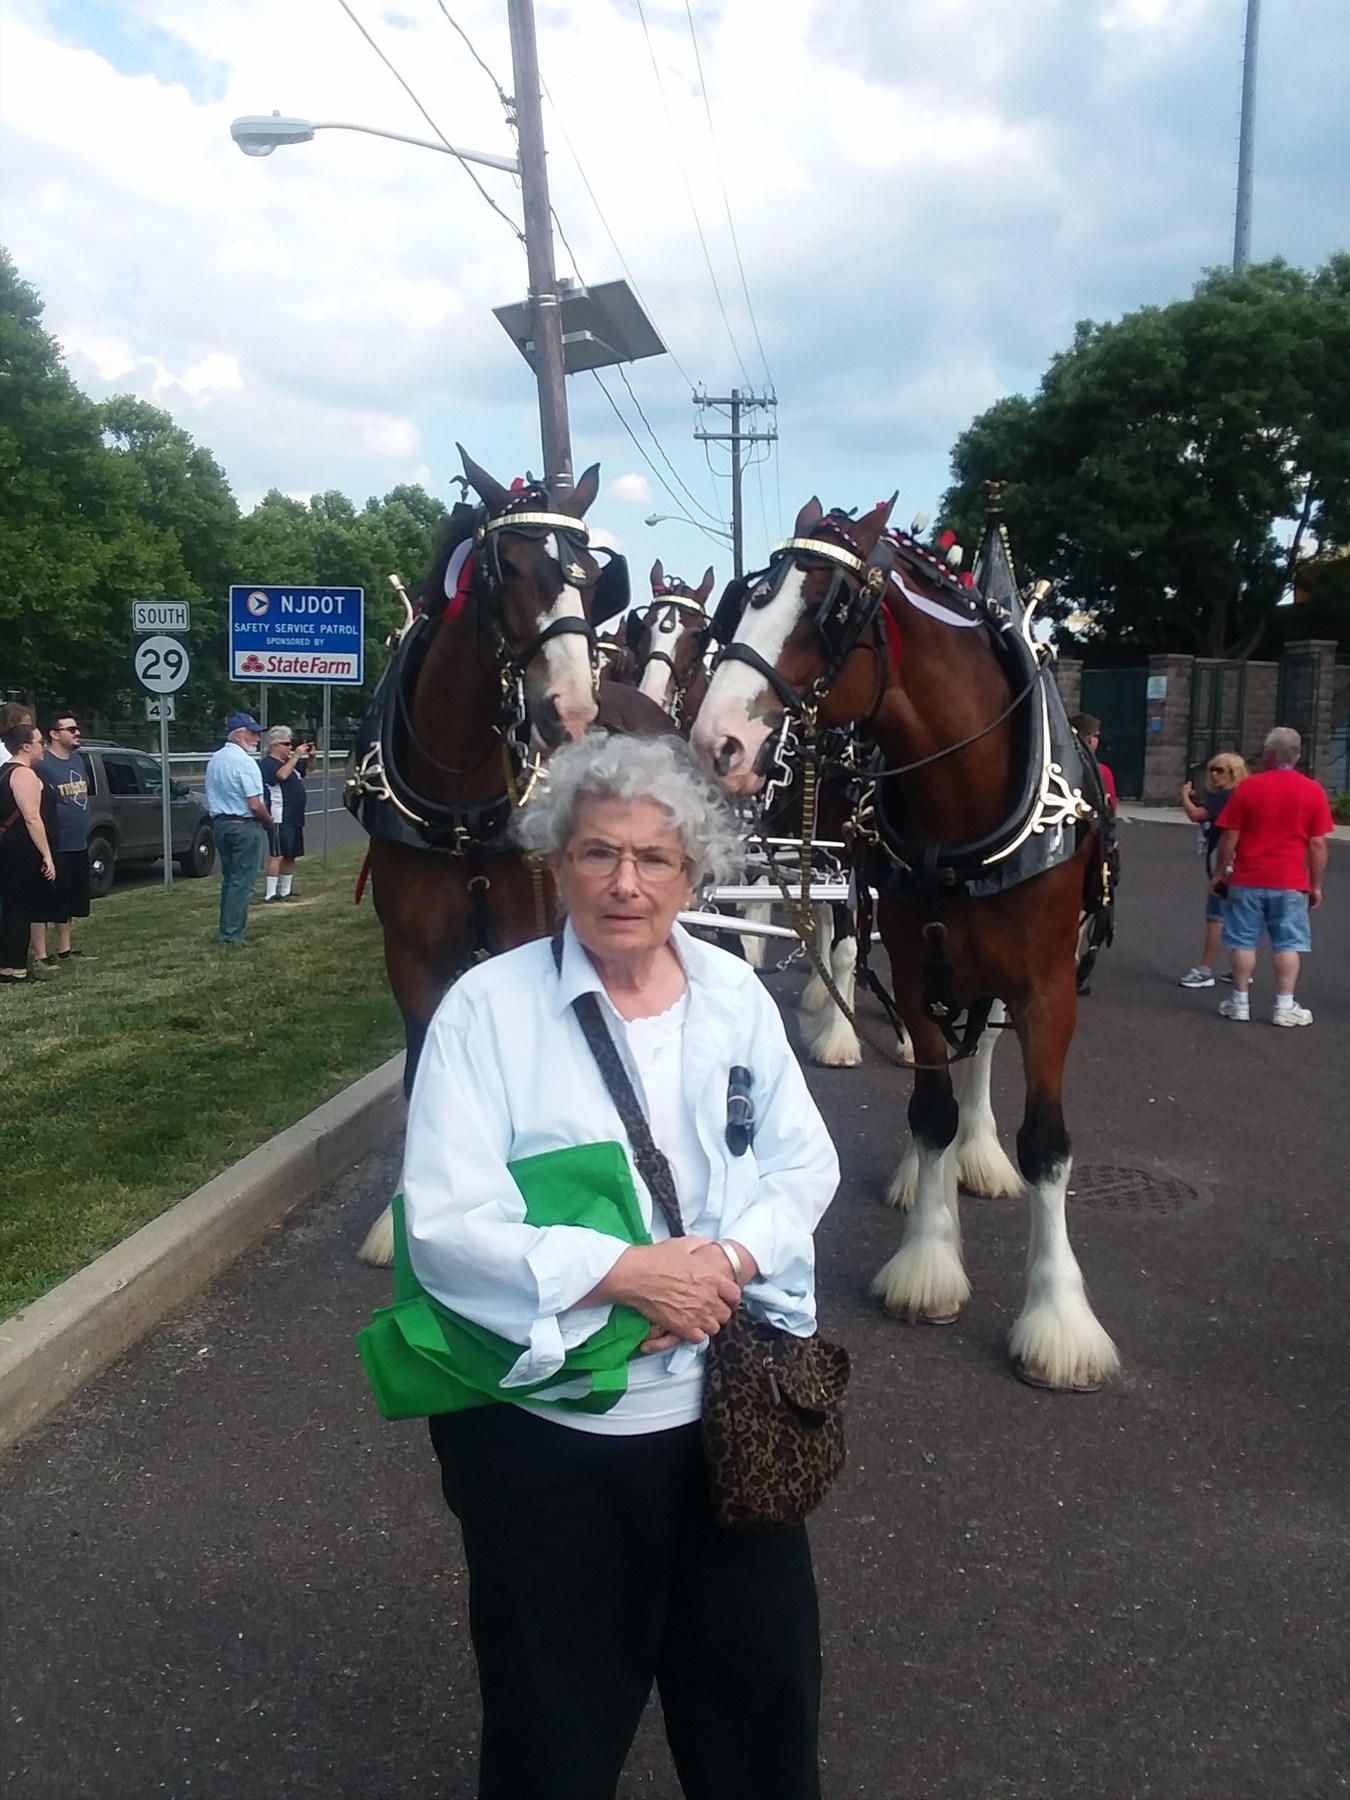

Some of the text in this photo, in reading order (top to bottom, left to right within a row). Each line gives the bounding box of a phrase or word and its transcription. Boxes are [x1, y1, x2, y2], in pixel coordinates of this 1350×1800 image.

[281, 595, 345, 614] NJDOT
[138, 608, 185, 624] SOUTH
[234, 622, 358, 635] SAFETY SERVICE PATROL
[266, 637, 325, 646] SPONSORED BY
[141, 648, 183, 680] 29
